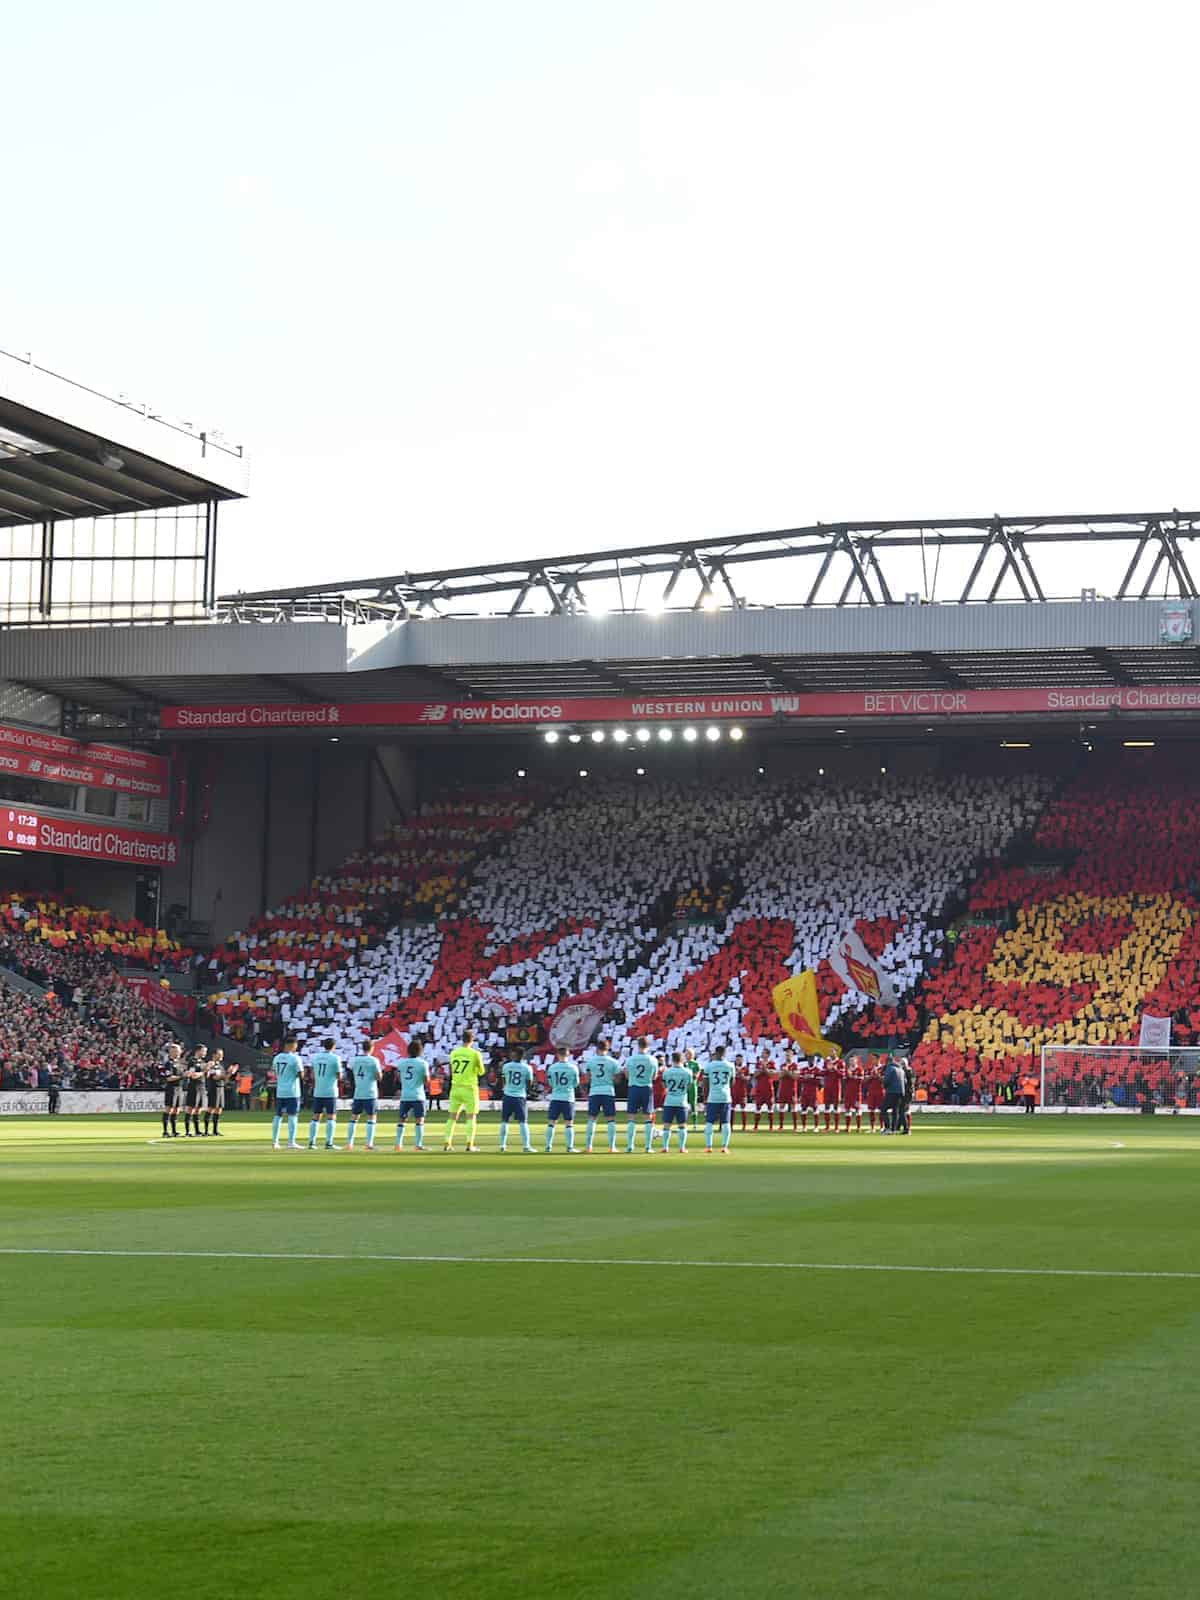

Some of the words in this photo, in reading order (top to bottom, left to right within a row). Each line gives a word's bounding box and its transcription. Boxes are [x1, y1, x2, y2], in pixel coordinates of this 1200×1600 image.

[1047, 691, 1121, 707] Standard
[453, 706, 487, 720] new
[491, 702, 562, 719] balance
[632, 702, 706, 714] WESTERN
[711, 700, 763, 713] UNION
[177, 709, 246, 724] Standard
[250, 707, 325, 722] Chartered
[61, 764, 94, 781] balance
[9, 811, 14, 822] 0
[8, 830, 13, 841] 0
[41, 825, 102, 853] Standard
[104, 833, 166, 860] Chartered
[276, 1062, 287, 1075] 17
[318, 1063, 327, 1077] 11
[357, 1066, 365, 1080] 4
[405, 1066, 413, 1080] 5
[452, 1060, 470, 1074] 27
[597, 1063, 605, 1078] 3
[636, 1064, 645, 1078] 2
[508, 1071, 521, 1086] 18
[555, 1071, 569, 1086] 16
[712, 1071, 729, 1085] 33
[668, 1078, 685, 1093] 24
